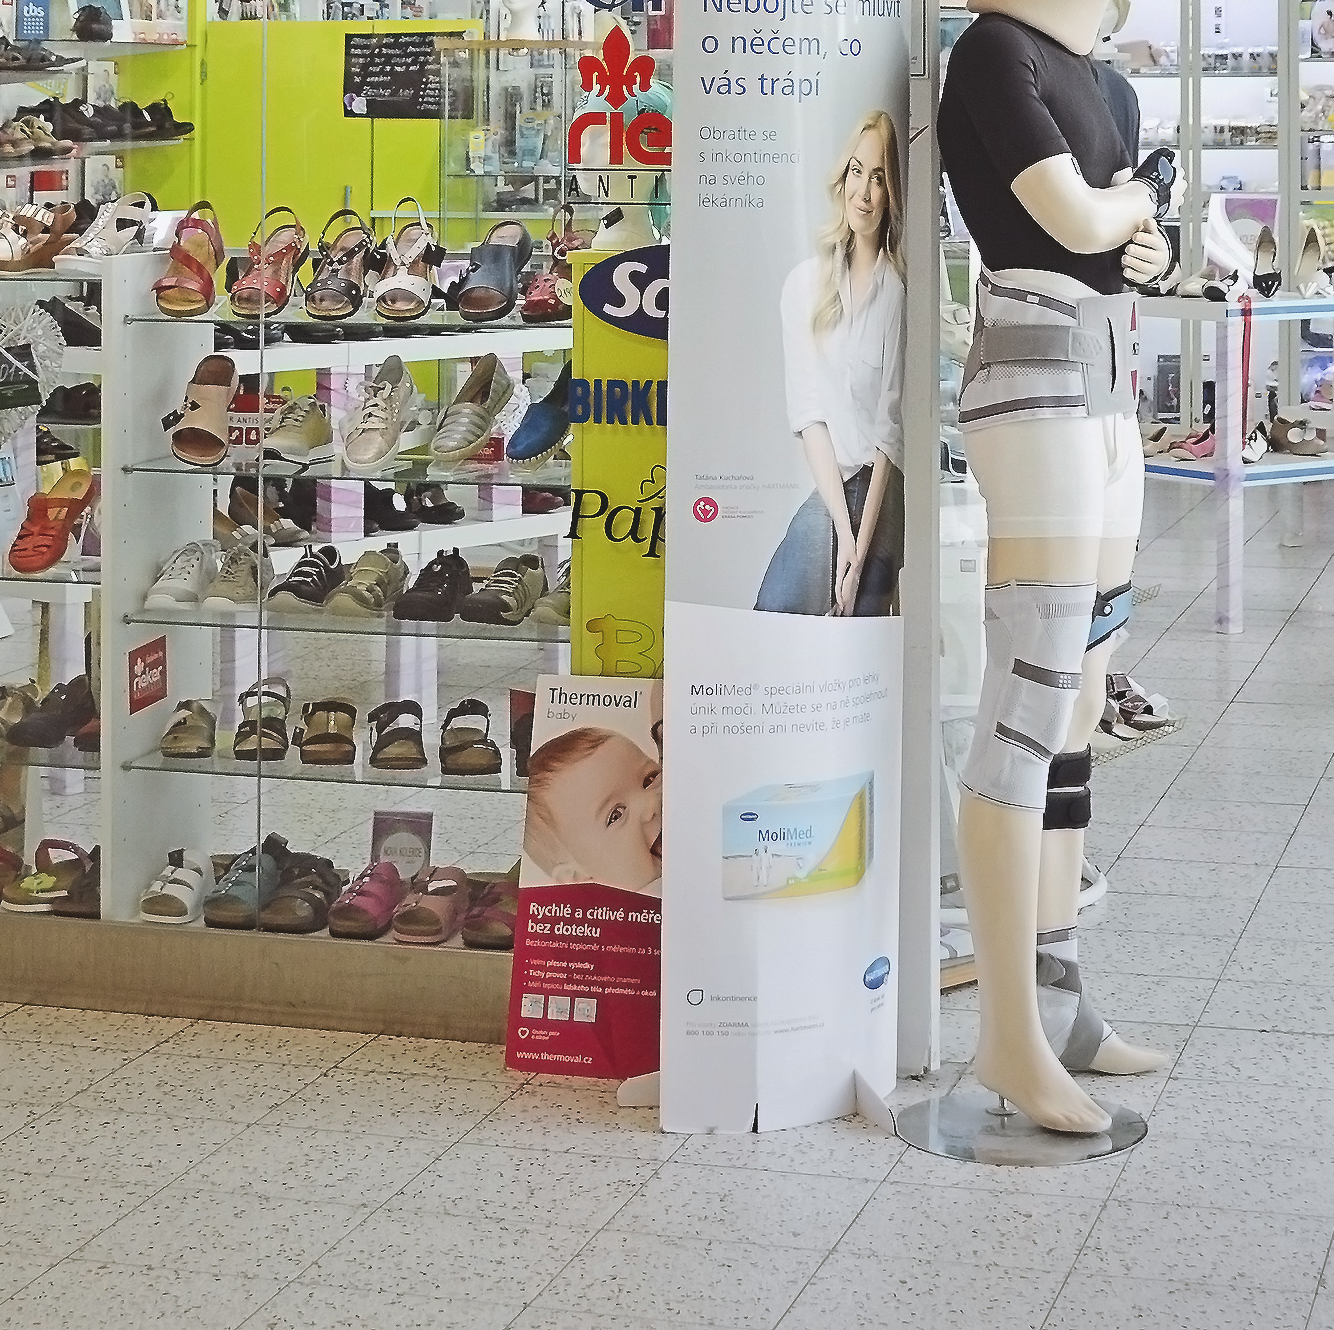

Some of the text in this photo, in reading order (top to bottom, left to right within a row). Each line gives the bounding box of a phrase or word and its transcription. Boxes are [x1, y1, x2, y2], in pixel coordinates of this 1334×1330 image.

[24, 2, 44, 17] tbs
[702, 28, 862, 59] o něčem, co
[700, 70, 820, 102] vás trápí
[699, 126, 777, 142] Obraťte se
[698, 172, 765, 187] na svého
[698, 194, 764, 210] lékárníka
[764, 676, 861, 698] speciální vložky pro
[549, 686, 639, 710] Thermoval
[547, 709, 577, 722] baby
[690, 703, 716, 715] únik
[721, 703, 756, 716] moči.
[761, 701, 806, 715] Můžete
[811, 704, 822, 713] se
[826, 702, 837, 712] na
[689, 717, 841, 737] a při nošení ani nevíte, že
[529, 902, 662, 924] Rychlé a citlivé měře
[527, 919, 601, 938] bez doteku
[710, 994, 758, 1002] Inkontinence
[517, 1051, 593, 1065] www.thermoval.cz
